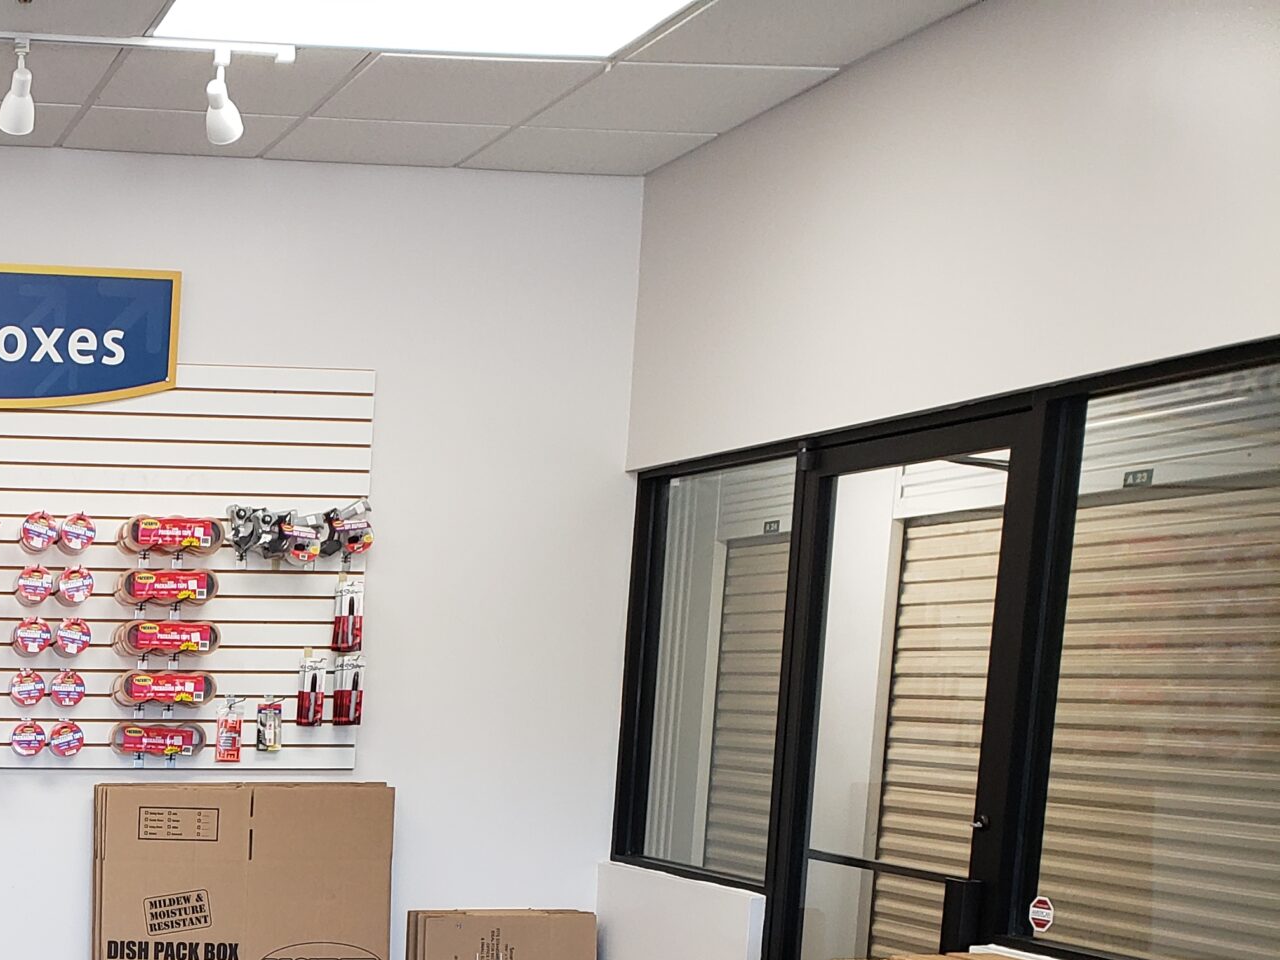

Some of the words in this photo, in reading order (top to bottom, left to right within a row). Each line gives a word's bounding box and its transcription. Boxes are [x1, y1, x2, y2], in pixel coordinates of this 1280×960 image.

[149, 894, 192, 910] MILDEW
[195, 893, 204, 903] &
[149, 903, 206, 922] MOISTURE
[149, 914, 209, 932] RESISTANT
[107, 940, 149, 960] DISH
